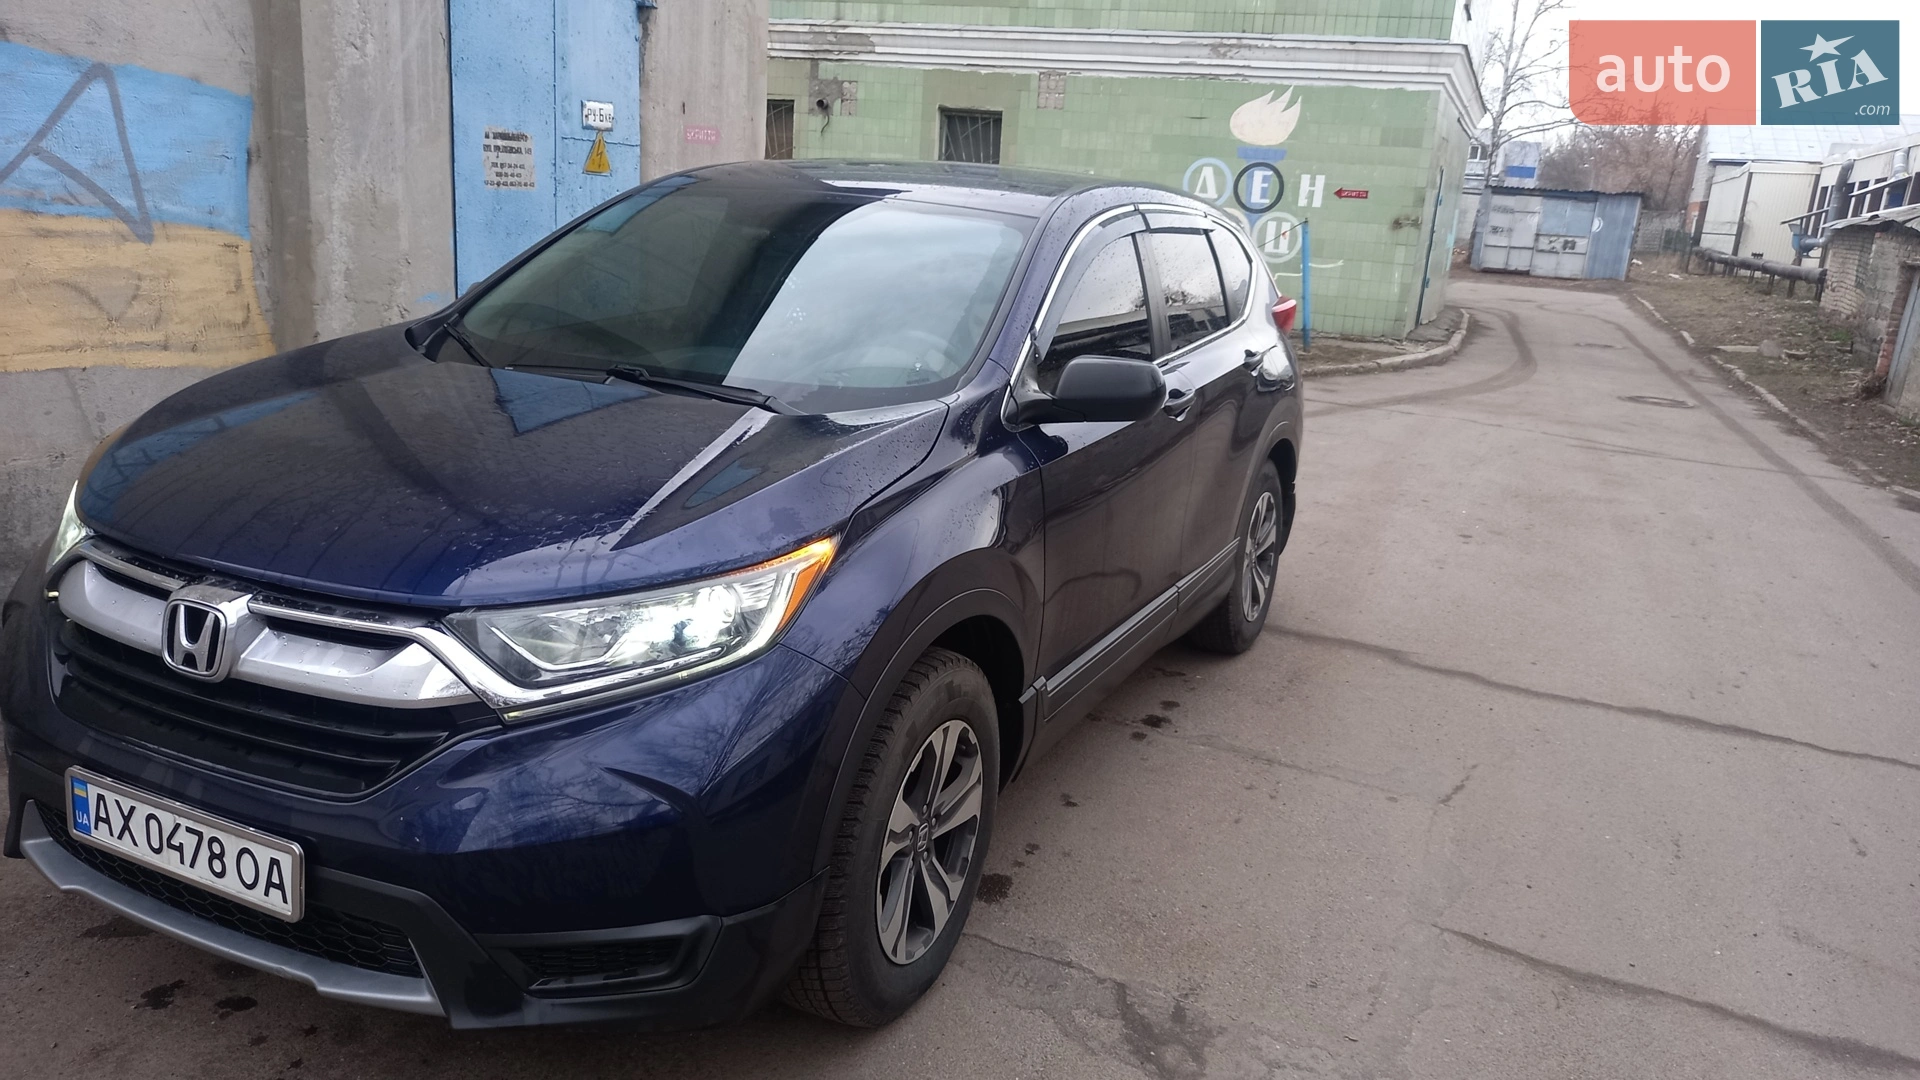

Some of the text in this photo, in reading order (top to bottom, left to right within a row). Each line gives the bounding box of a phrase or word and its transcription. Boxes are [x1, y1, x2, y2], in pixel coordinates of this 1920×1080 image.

[75, 809, 90, 827] UA
[94, 793, 139, 847] AX
[145, 812, 227, 879] 0478
